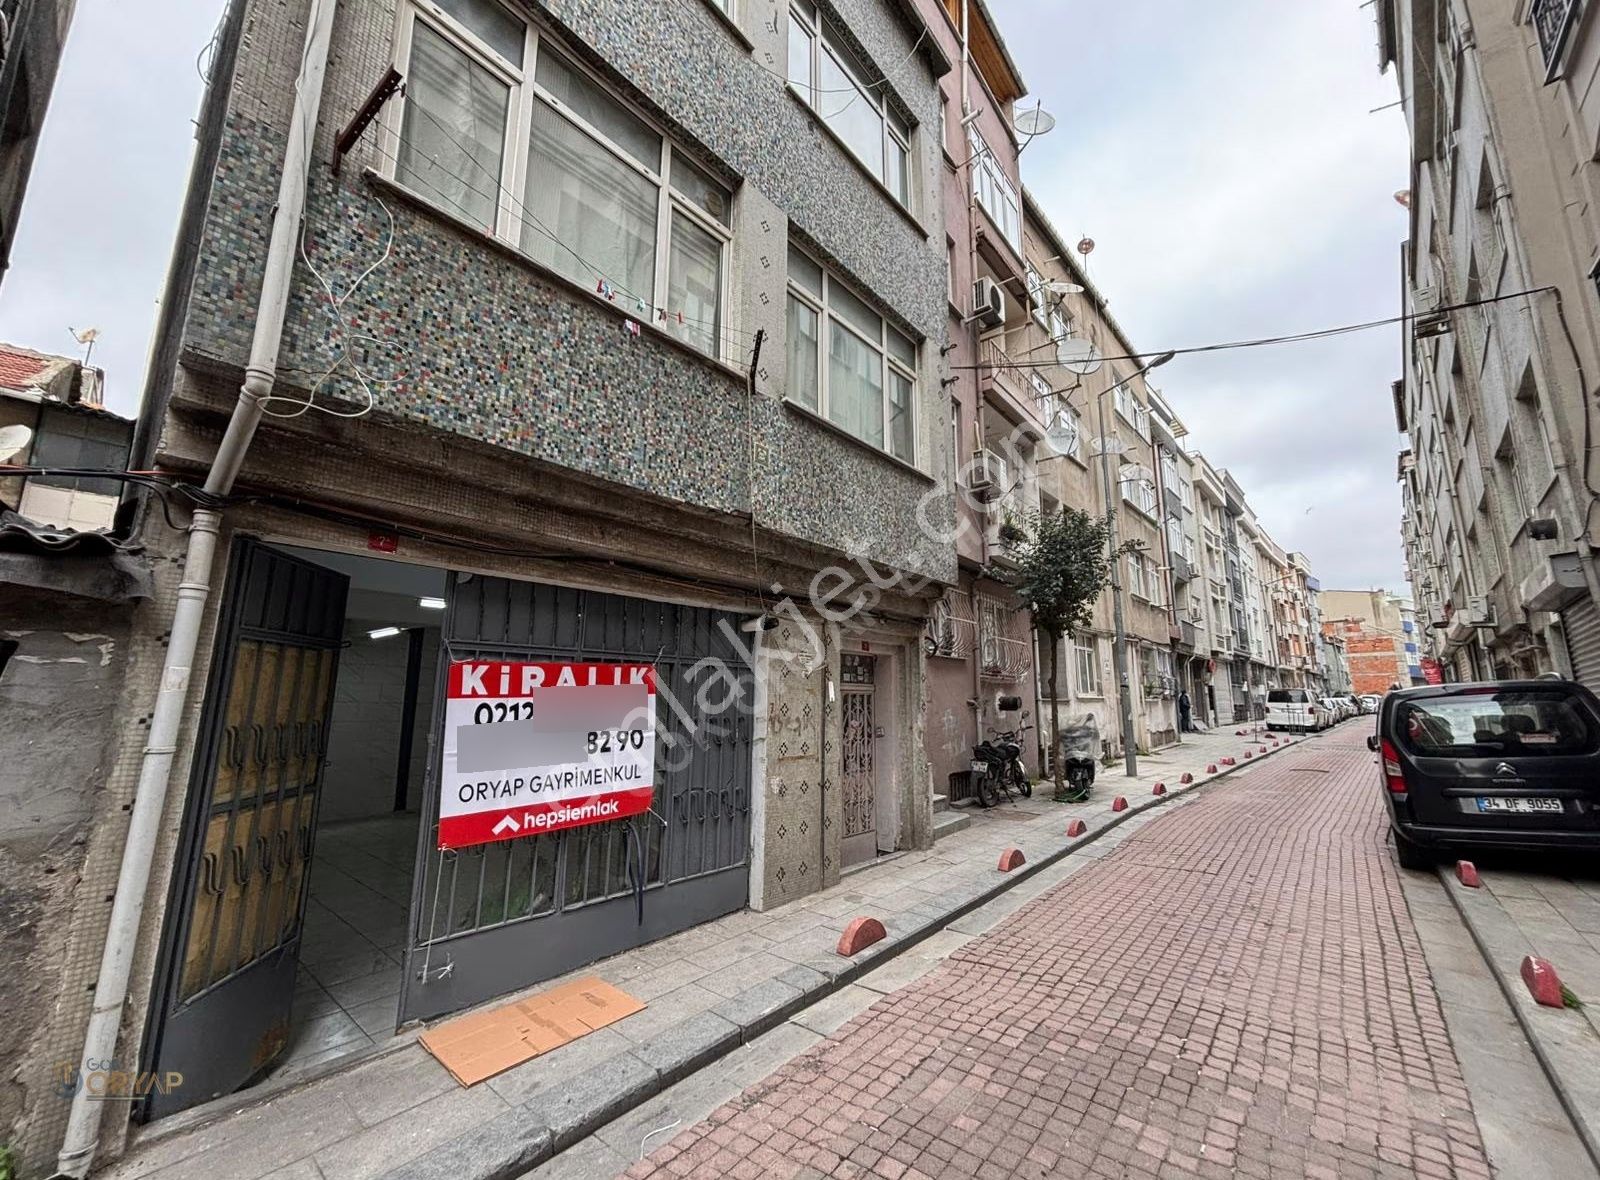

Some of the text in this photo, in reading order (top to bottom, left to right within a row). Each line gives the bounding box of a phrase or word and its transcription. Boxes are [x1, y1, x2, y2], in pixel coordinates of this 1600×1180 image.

[474, 702, 533, 725] 0212
[458, 764, 641, 803] ORYAP GAYRİMENKUL
[524, 799, 619, 829] hepsiemlak
